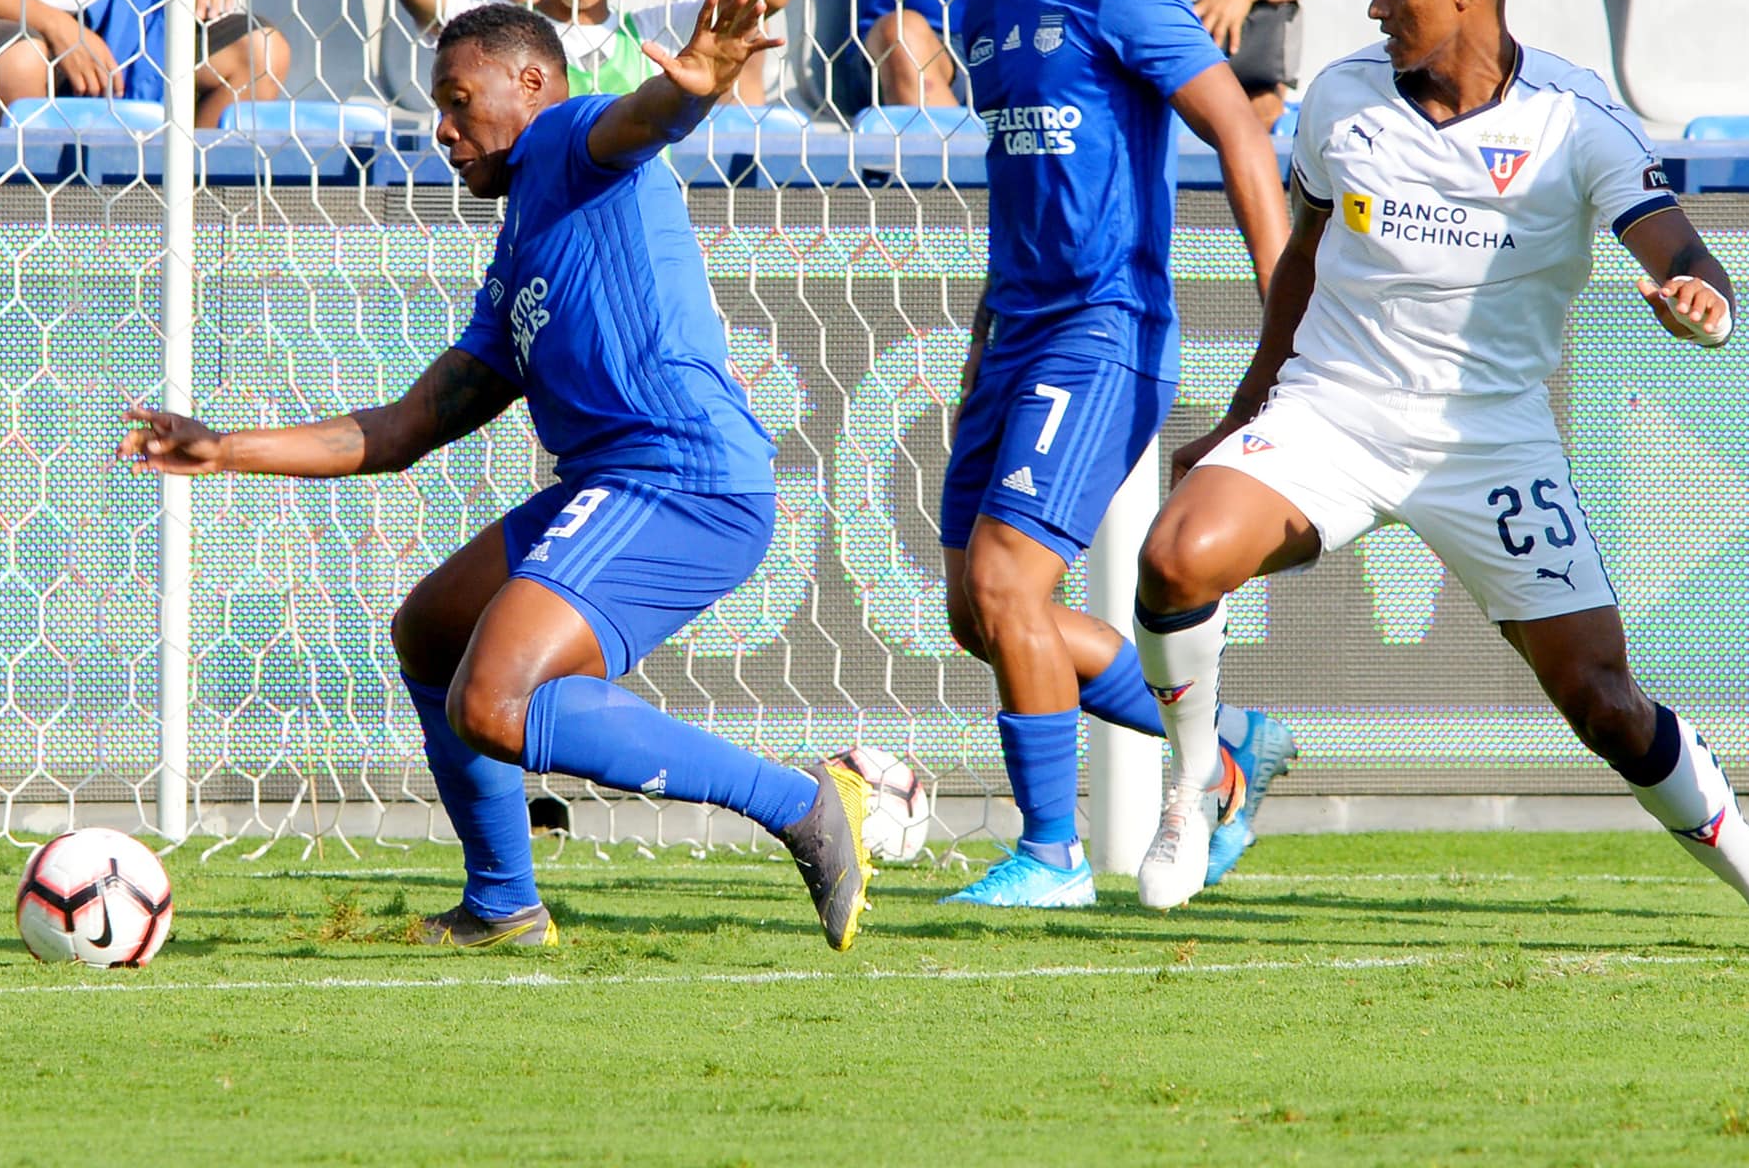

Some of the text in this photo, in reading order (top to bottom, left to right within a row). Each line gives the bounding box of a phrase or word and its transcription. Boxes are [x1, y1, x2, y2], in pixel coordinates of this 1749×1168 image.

[997, 105, 1082, 131] ELECTRO
[1003, 130, 1076, 156] CABLES
[1381, 199, 1468, 225] BANCO
[1380, 221, 1517, 250] PICHINCHA
[1035, 382, 1072, 455] 7
[543, 487, 611, 539] 9
[1487, 478, 1576, 557] 25
